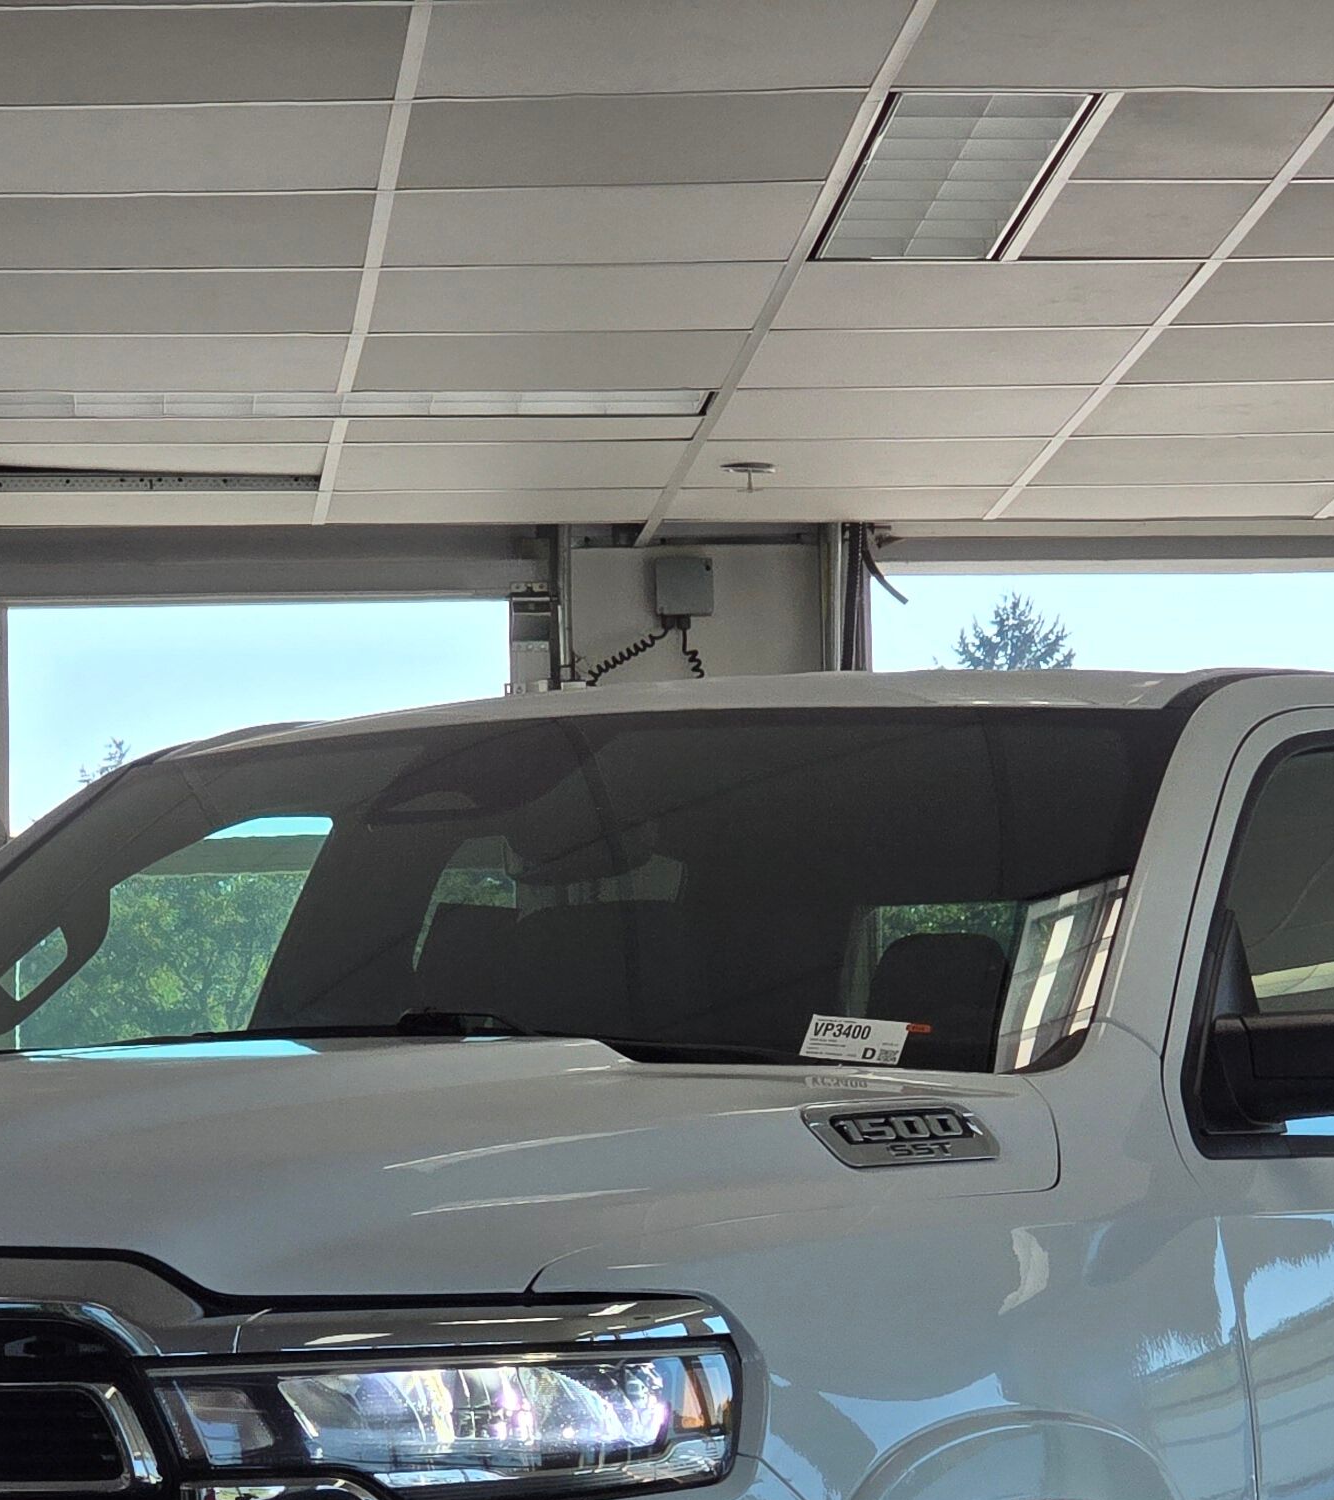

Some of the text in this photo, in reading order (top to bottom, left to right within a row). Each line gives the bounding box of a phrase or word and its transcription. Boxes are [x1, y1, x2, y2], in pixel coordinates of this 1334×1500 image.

[813, 1022, 871, 1040] VP3400
[861, 1047, 876, 1060] D
[840, 1115, 963, 1142] 1500
[887, 1141, 952, 1158] SST
